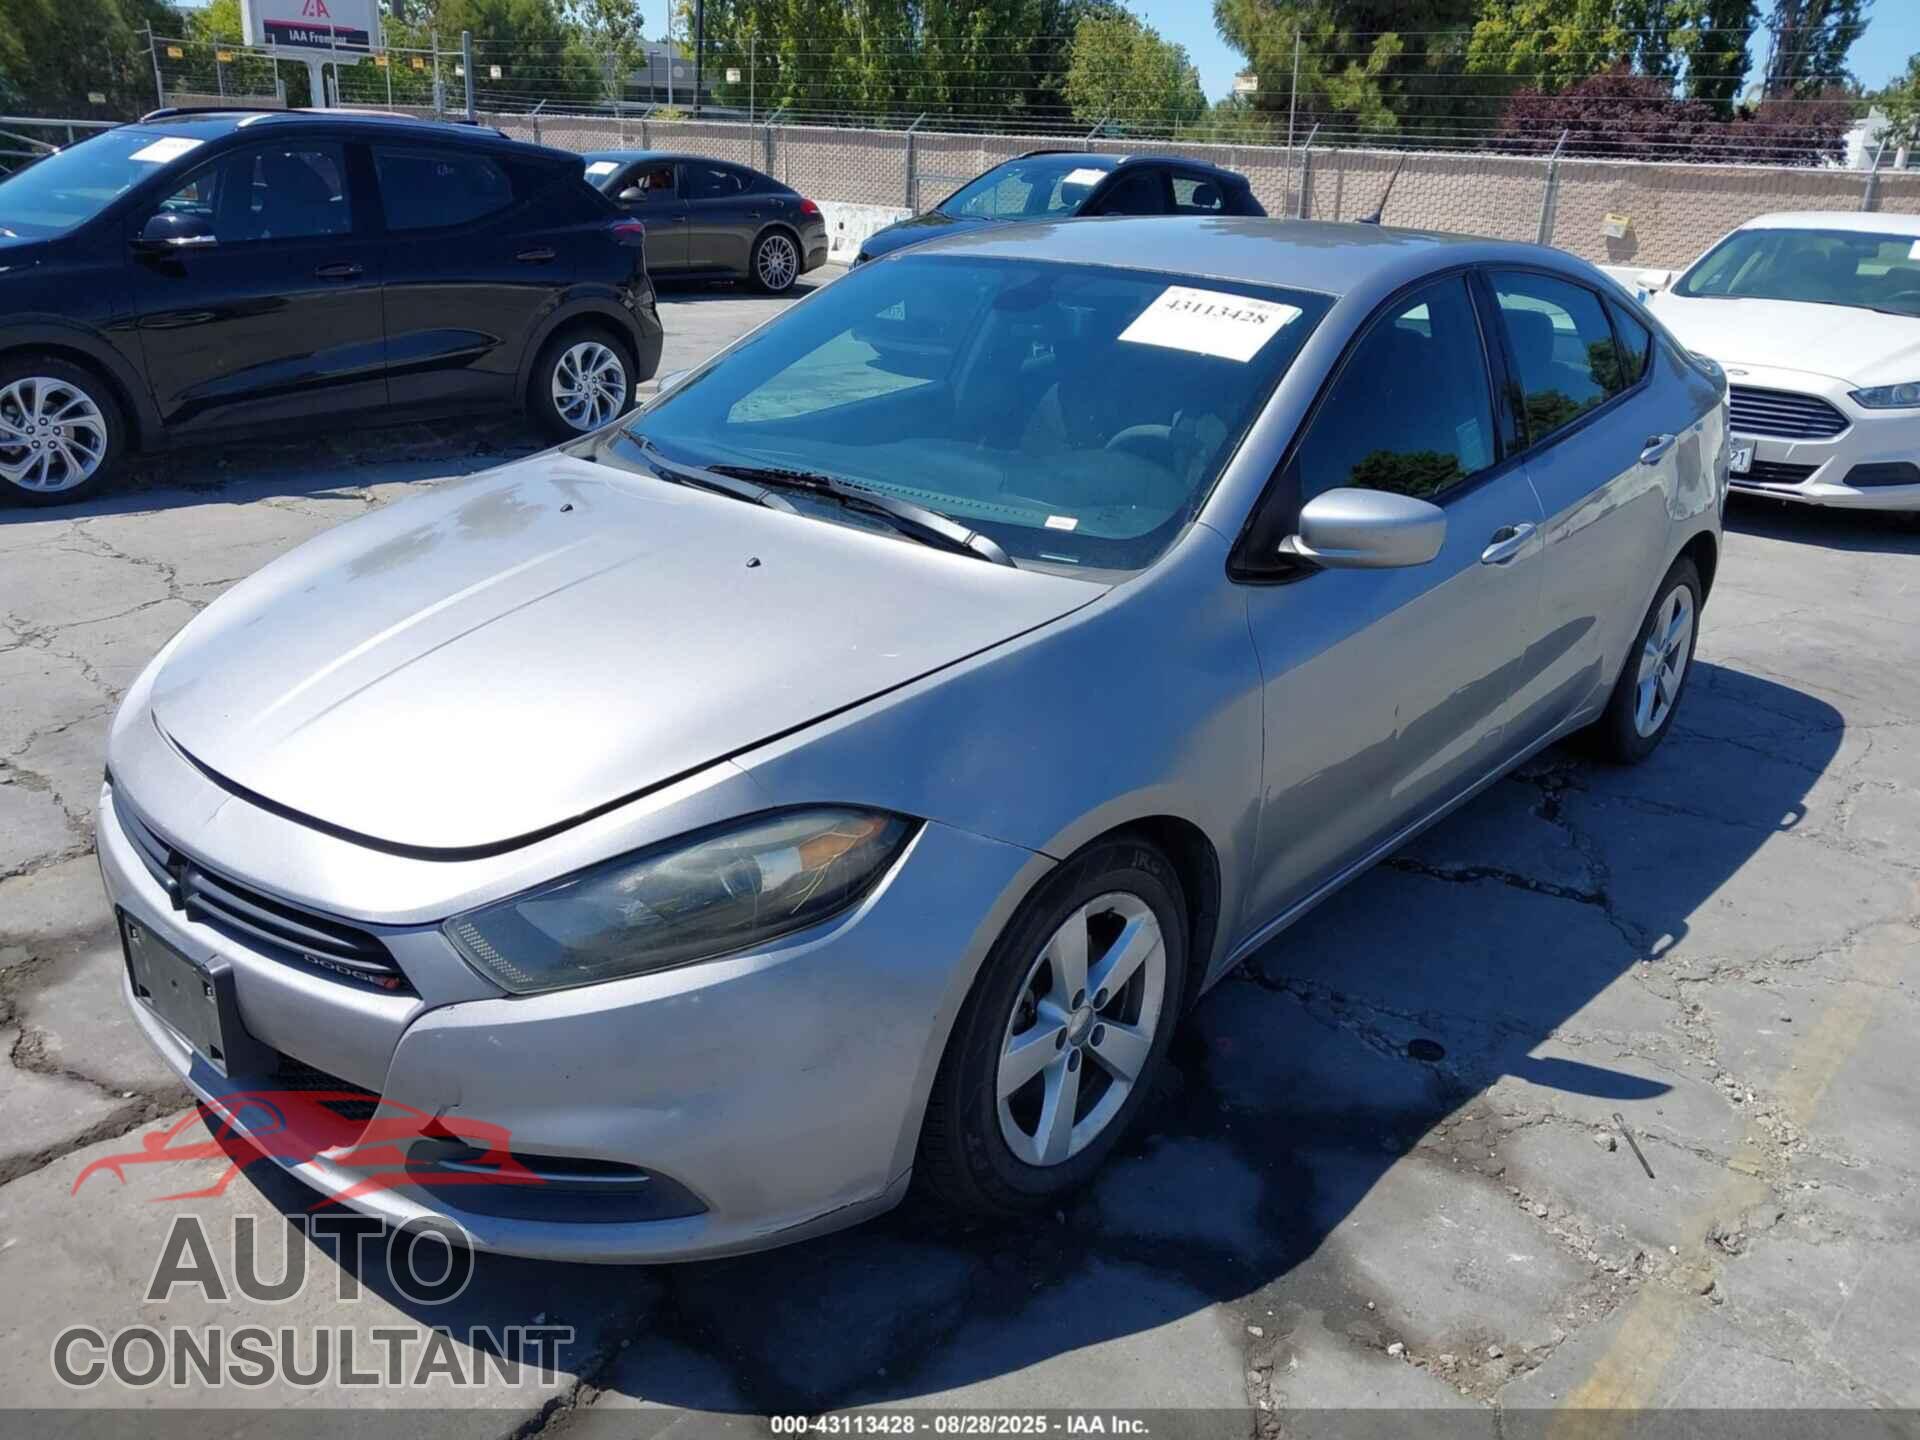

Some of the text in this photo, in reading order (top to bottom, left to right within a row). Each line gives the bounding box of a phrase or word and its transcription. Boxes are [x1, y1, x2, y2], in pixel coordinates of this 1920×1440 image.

[288, 29, 347, 44] IAA Fremnt
[1166, 299, 1269, 323] 43113428
